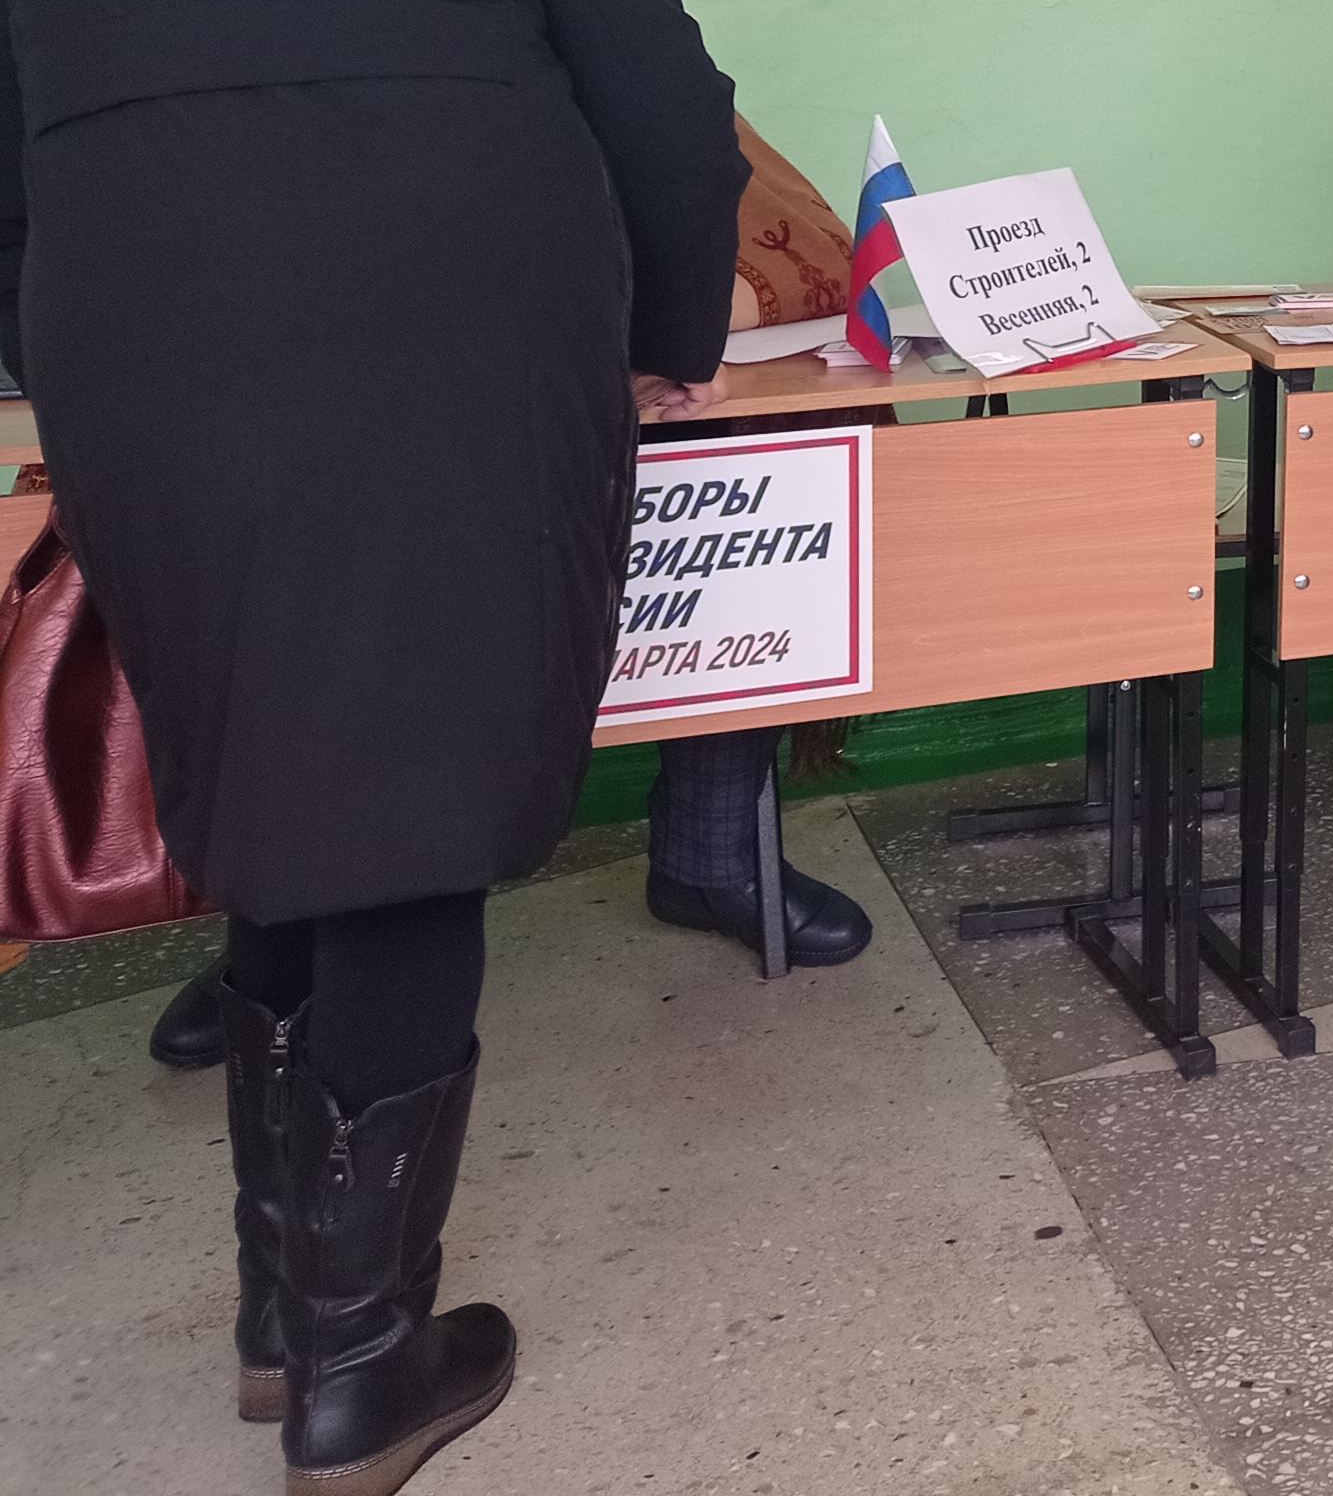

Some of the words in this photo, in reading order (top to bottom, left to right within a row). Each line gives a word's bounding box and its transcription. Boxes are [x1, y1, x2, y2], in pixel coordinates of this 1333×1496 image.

[966, 217, 1046, 253] Проезд
[949, 246, 1078, 300] Строителей,
[1076, 241, 1092, 265] 2
[978, 292, 1087, 337] Весенняя,
[1082, 284, 1100, 306] 2
[631, 475, 772, 526] БОРЫ
[626, 522, 833, 582] ЗИДЕНТА
[611, 639, 703, 683] АРТА
[706, 629, 792, 672] 2024
